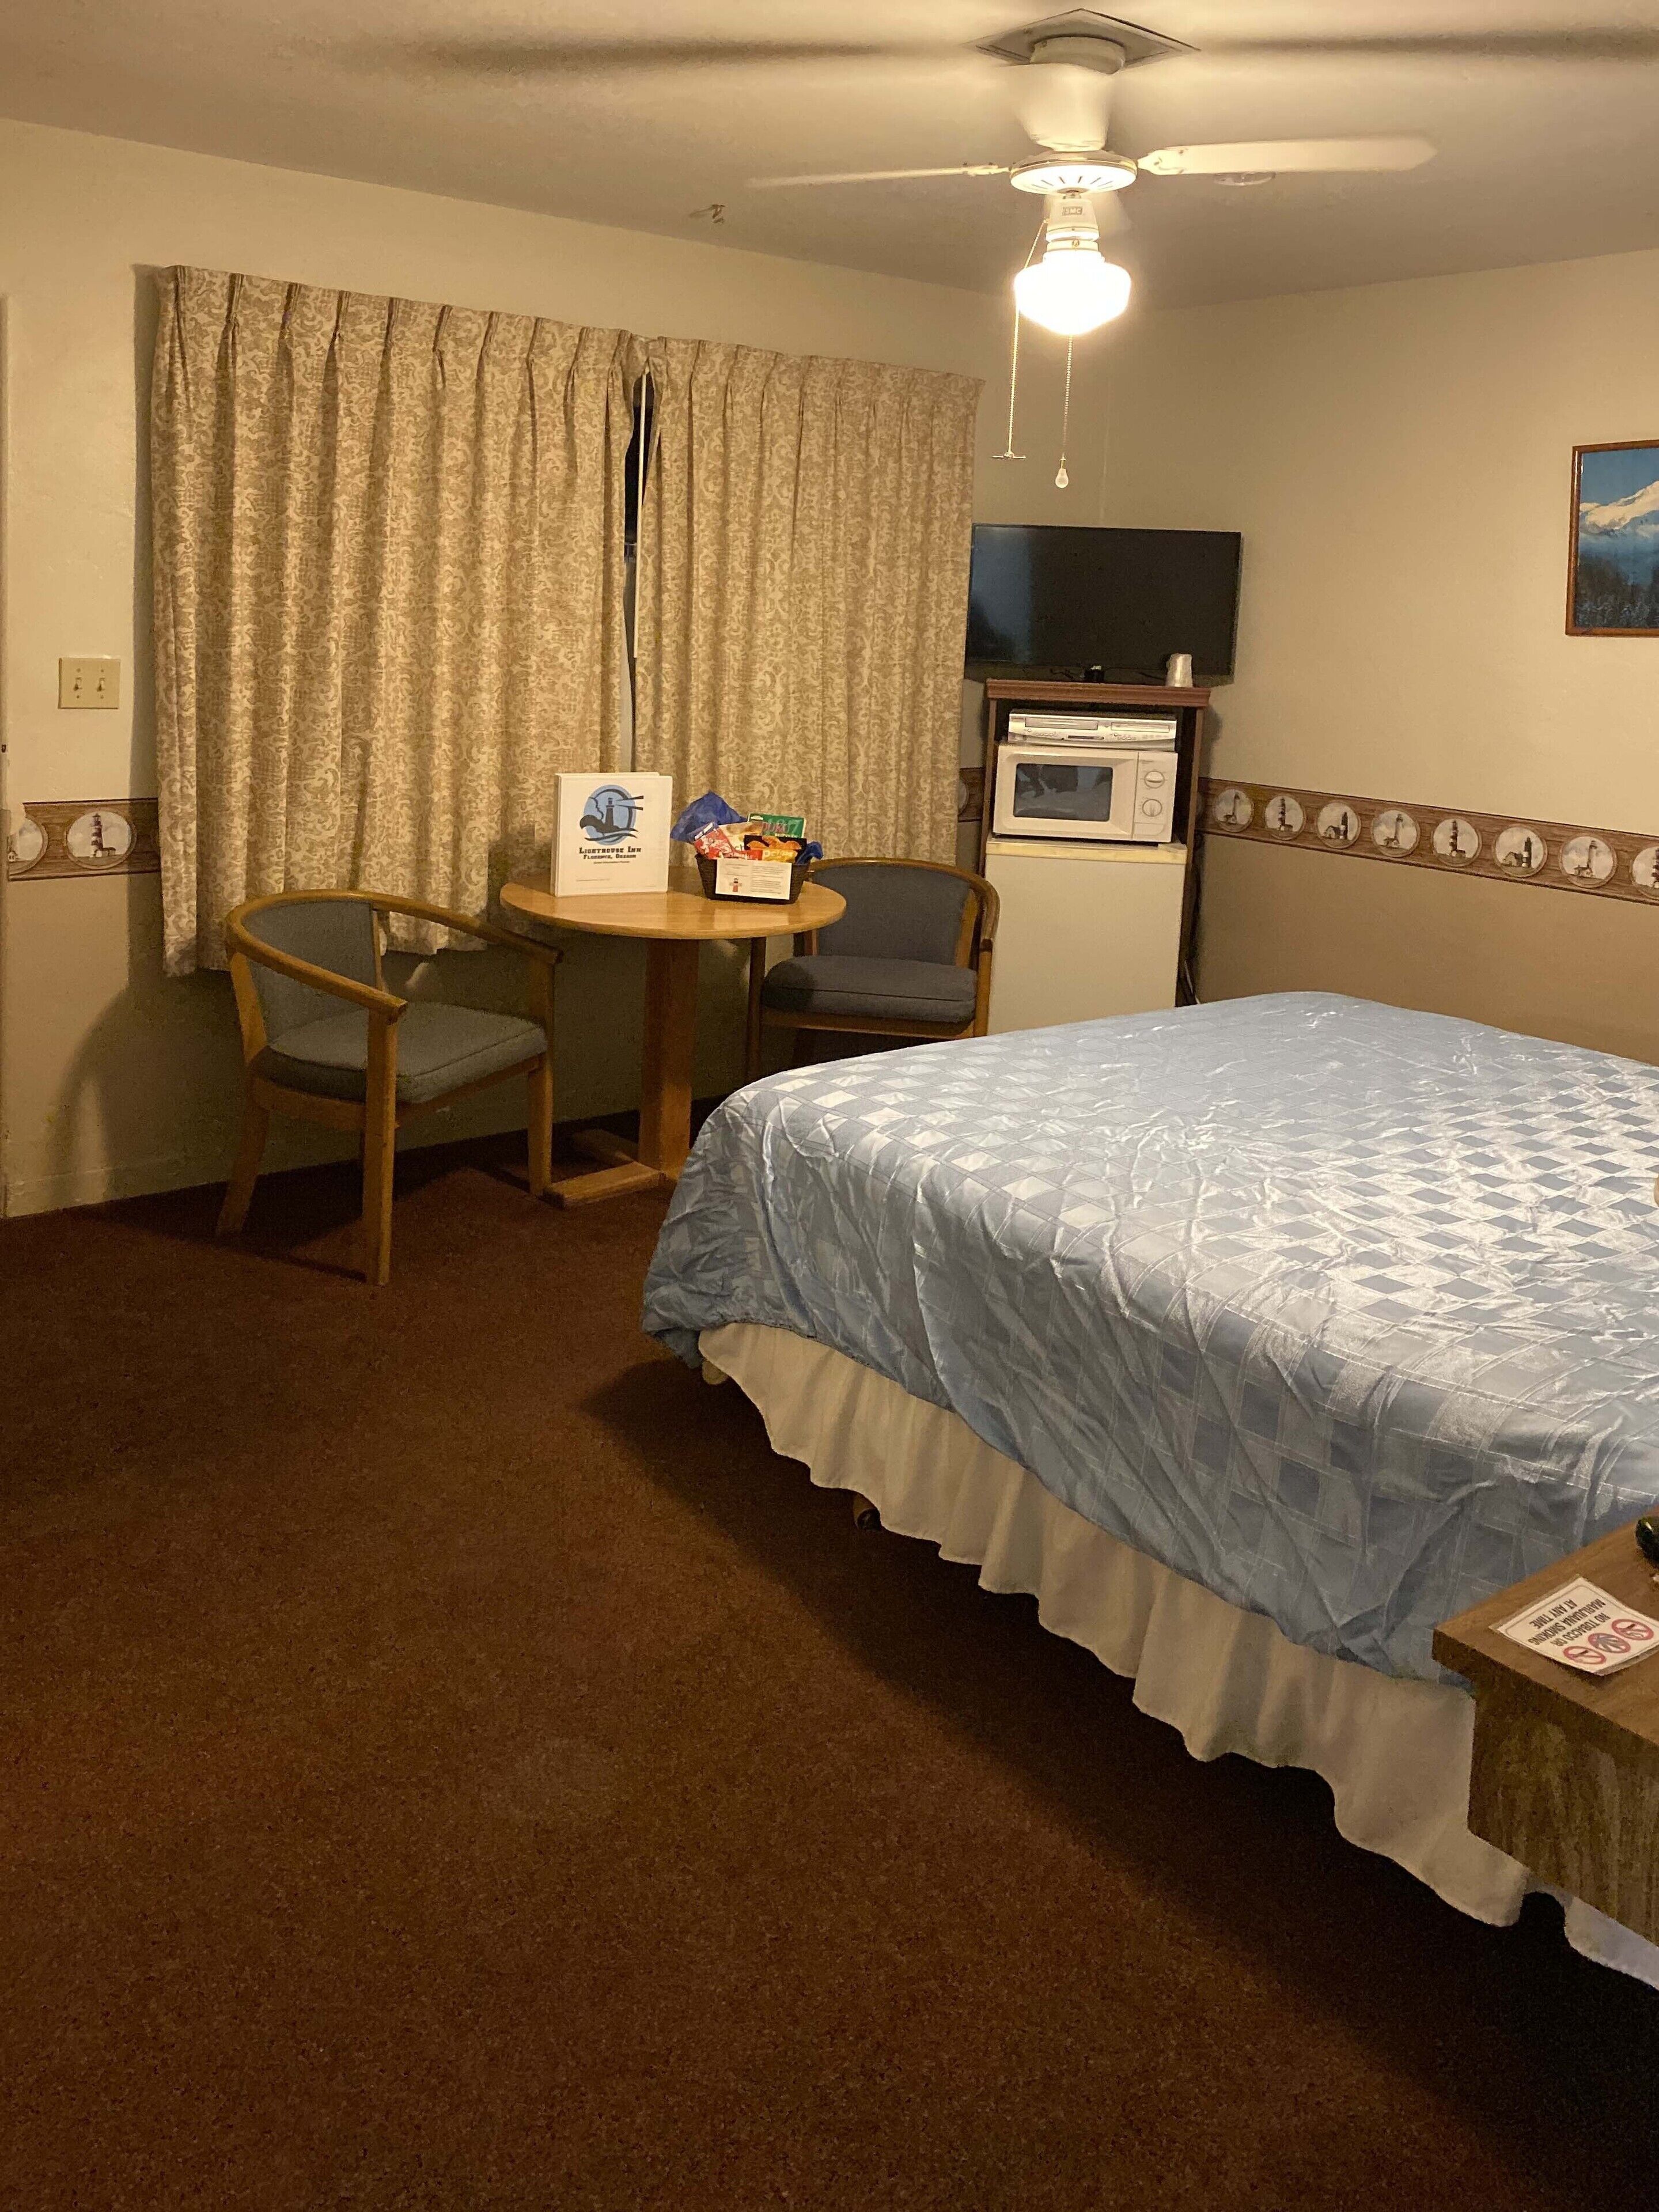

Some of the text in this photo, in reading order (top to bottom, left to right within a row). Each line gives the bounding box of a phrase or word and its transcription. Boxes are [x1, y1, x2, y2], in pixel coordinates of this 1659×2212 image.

[1528, 1599, 1606, 1645] MARIJUANA SMOKING
[1529, 1599, 1578, 1629] AT ANY TIME
[1550, 1612, 1611, 1646] NO TOBACCO OR
